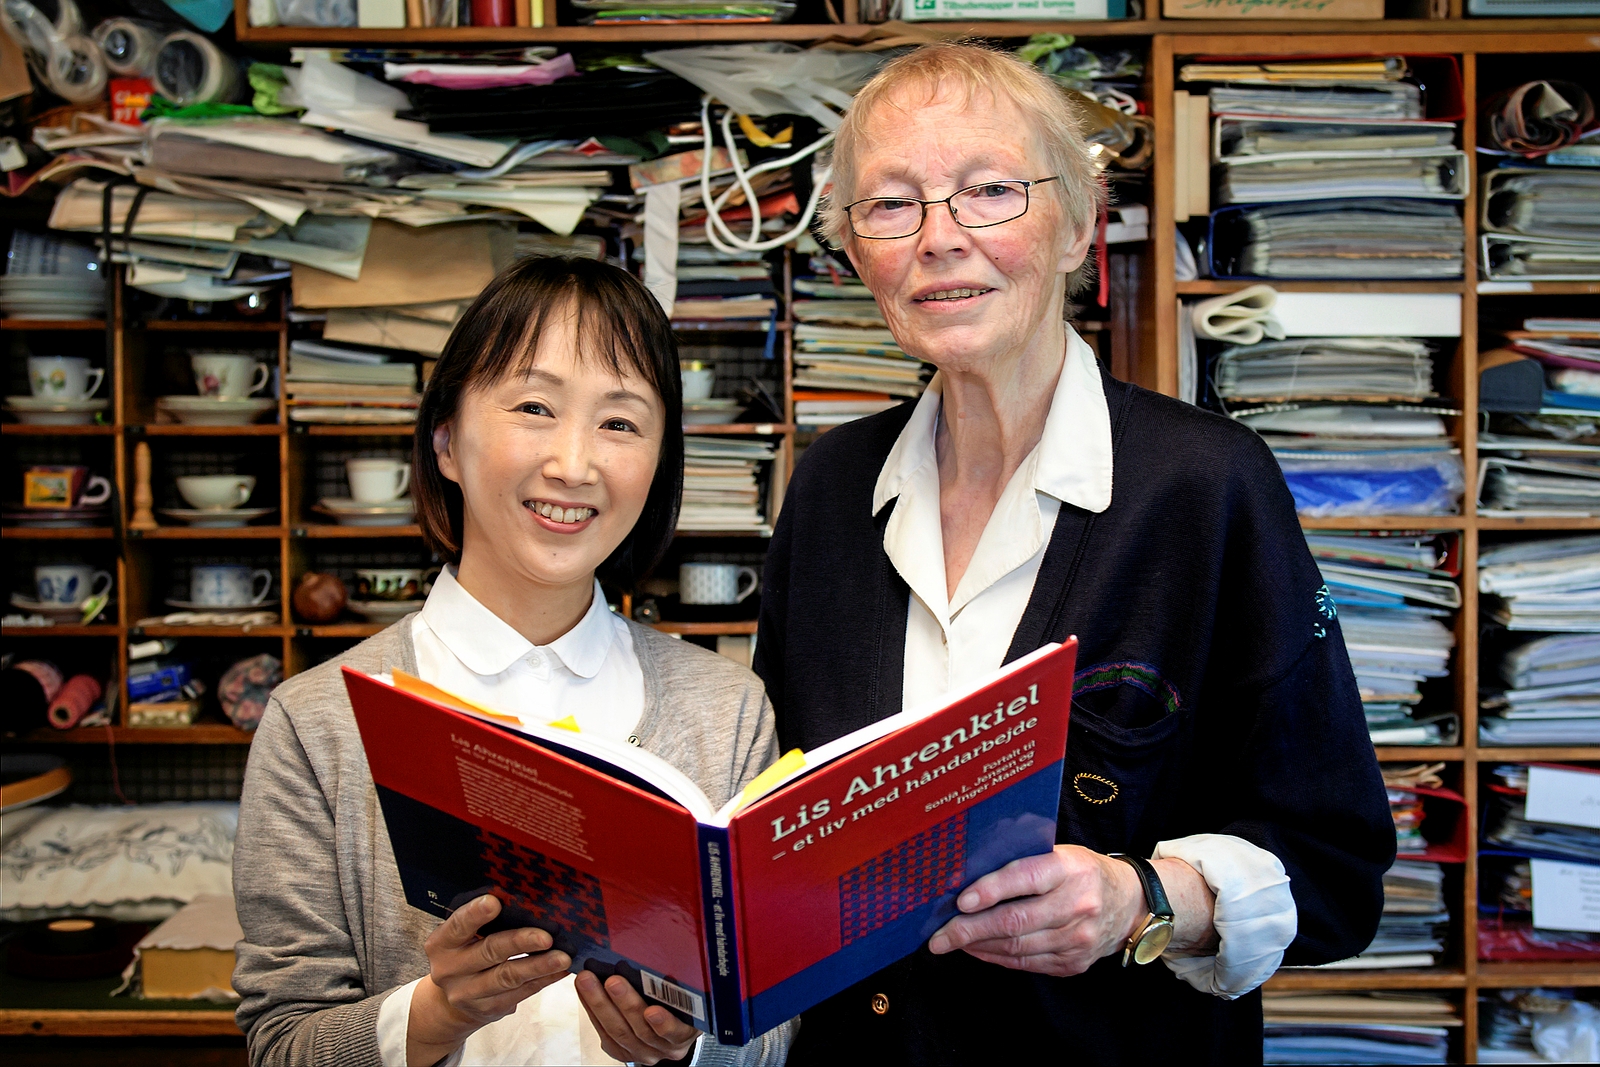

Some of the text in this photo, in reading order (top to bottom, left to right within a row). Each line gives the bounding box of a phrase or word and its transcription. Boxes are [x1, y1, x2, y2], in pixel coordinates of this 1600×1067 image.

[771, 683, 1040, 842] Lis Ahrenkiel
[793, 833, 814, 852] et
[819, 816, 847, 838] liv
[852, 787, 900, 822] med
[905, 717, 1038, 794] håndarbejde
[925, 790, 959, 813] Sonja
[974, 759, 1016, 787] Jensen
[1019, 751, 1035, 763] og
[983, 740, 1036, 773] Fortalt til
[956, 784, 989, 805] Inger
